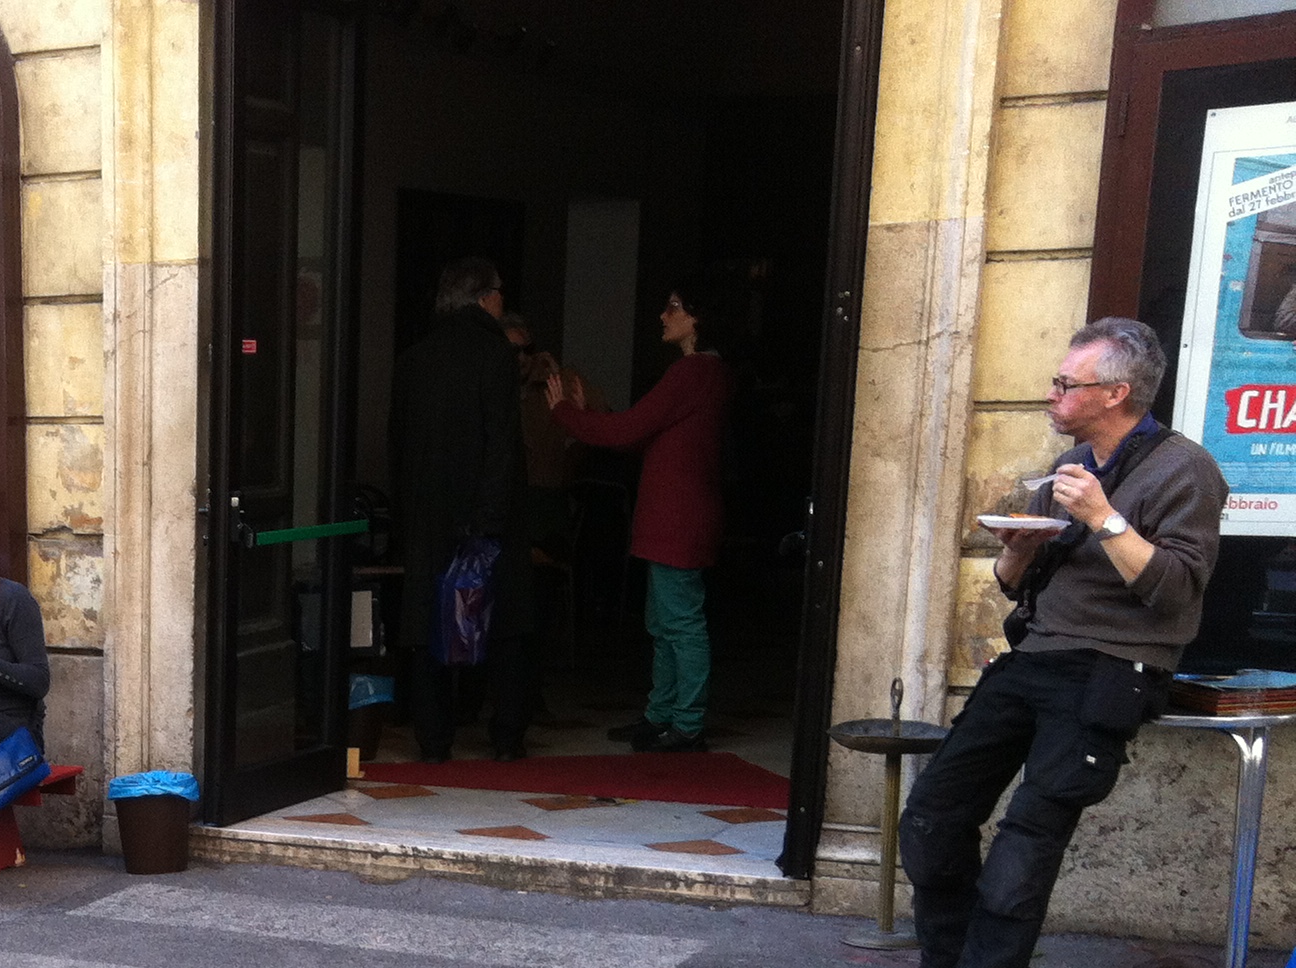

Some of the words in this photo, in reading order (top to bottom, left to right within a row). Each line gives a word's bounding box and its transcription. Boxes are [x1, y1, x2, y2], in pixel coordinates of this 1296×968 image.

[1229, 180, 1293, 207] FERMENTO
[1229, 205, 1245, 218] dal
[1248, 200, 1261, 211] 27
